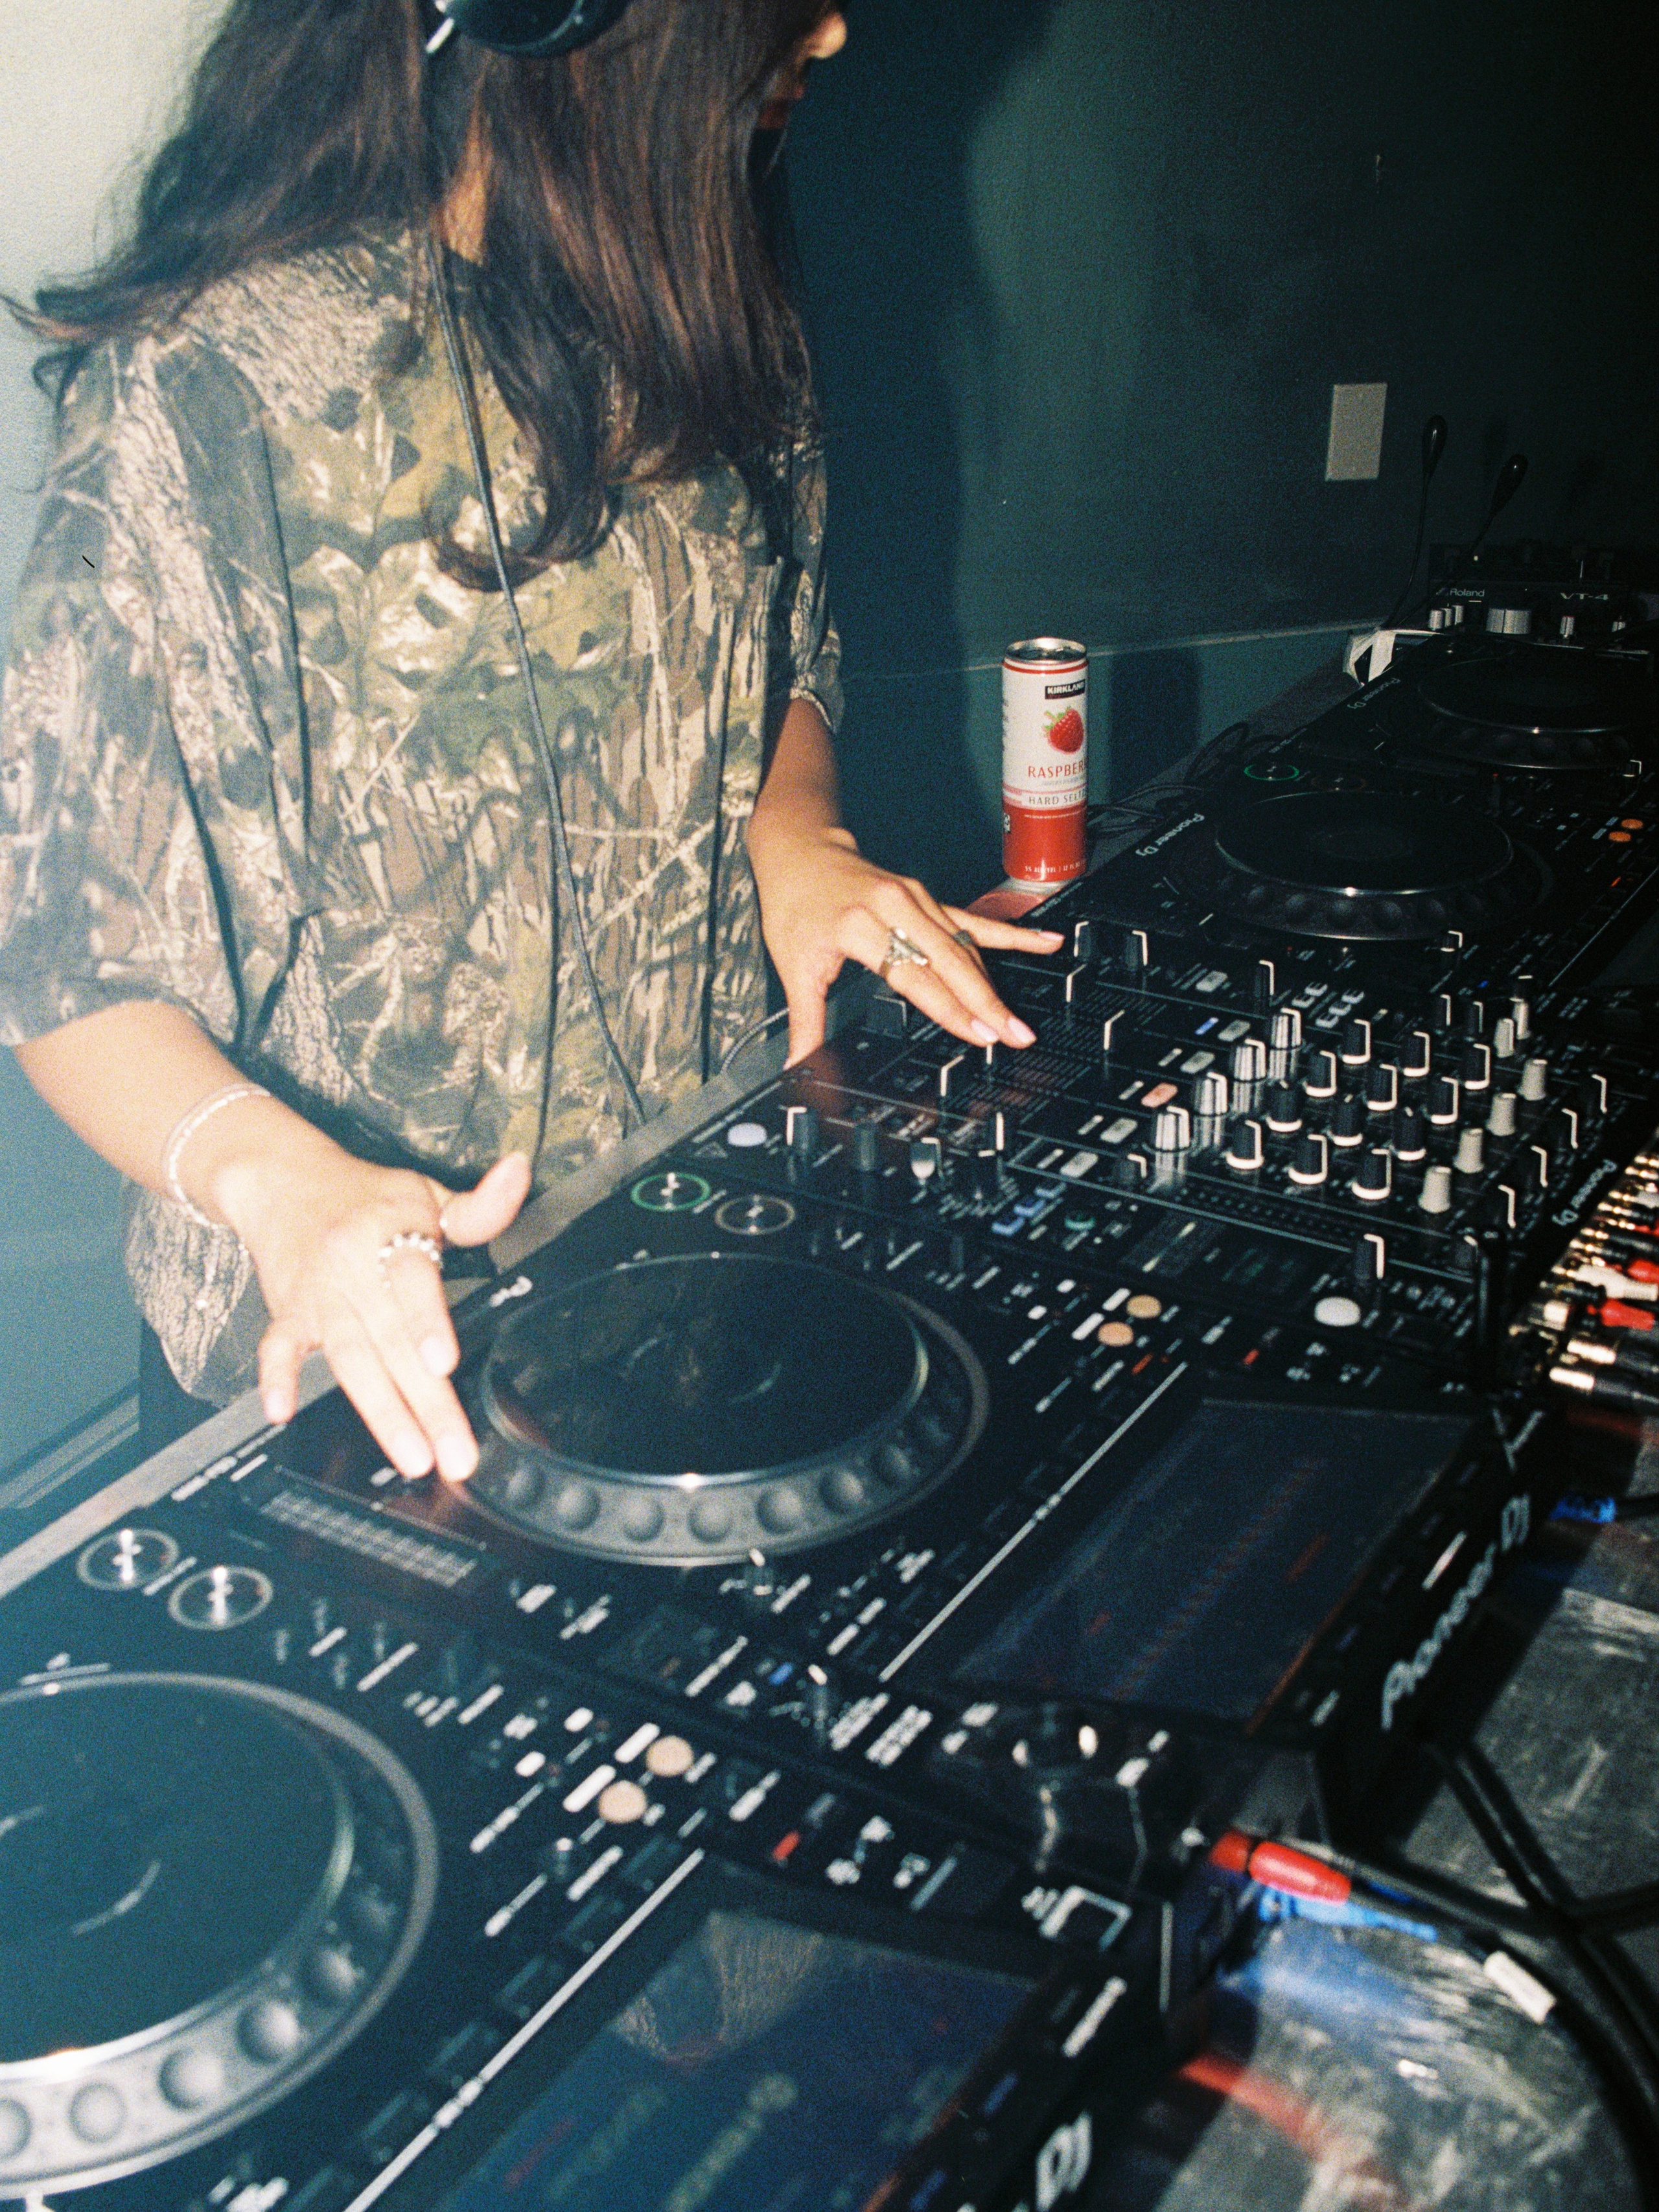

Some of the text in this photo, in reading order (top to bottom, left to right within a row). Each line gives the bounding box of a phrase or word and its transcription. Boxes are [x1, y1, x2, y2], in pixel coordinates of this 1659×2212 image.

[1450, 588, 1485, 597] Roland
[1047, 681, 1085, 695] KIRKLAND
[1028, 796, 1059, 805] HARD
